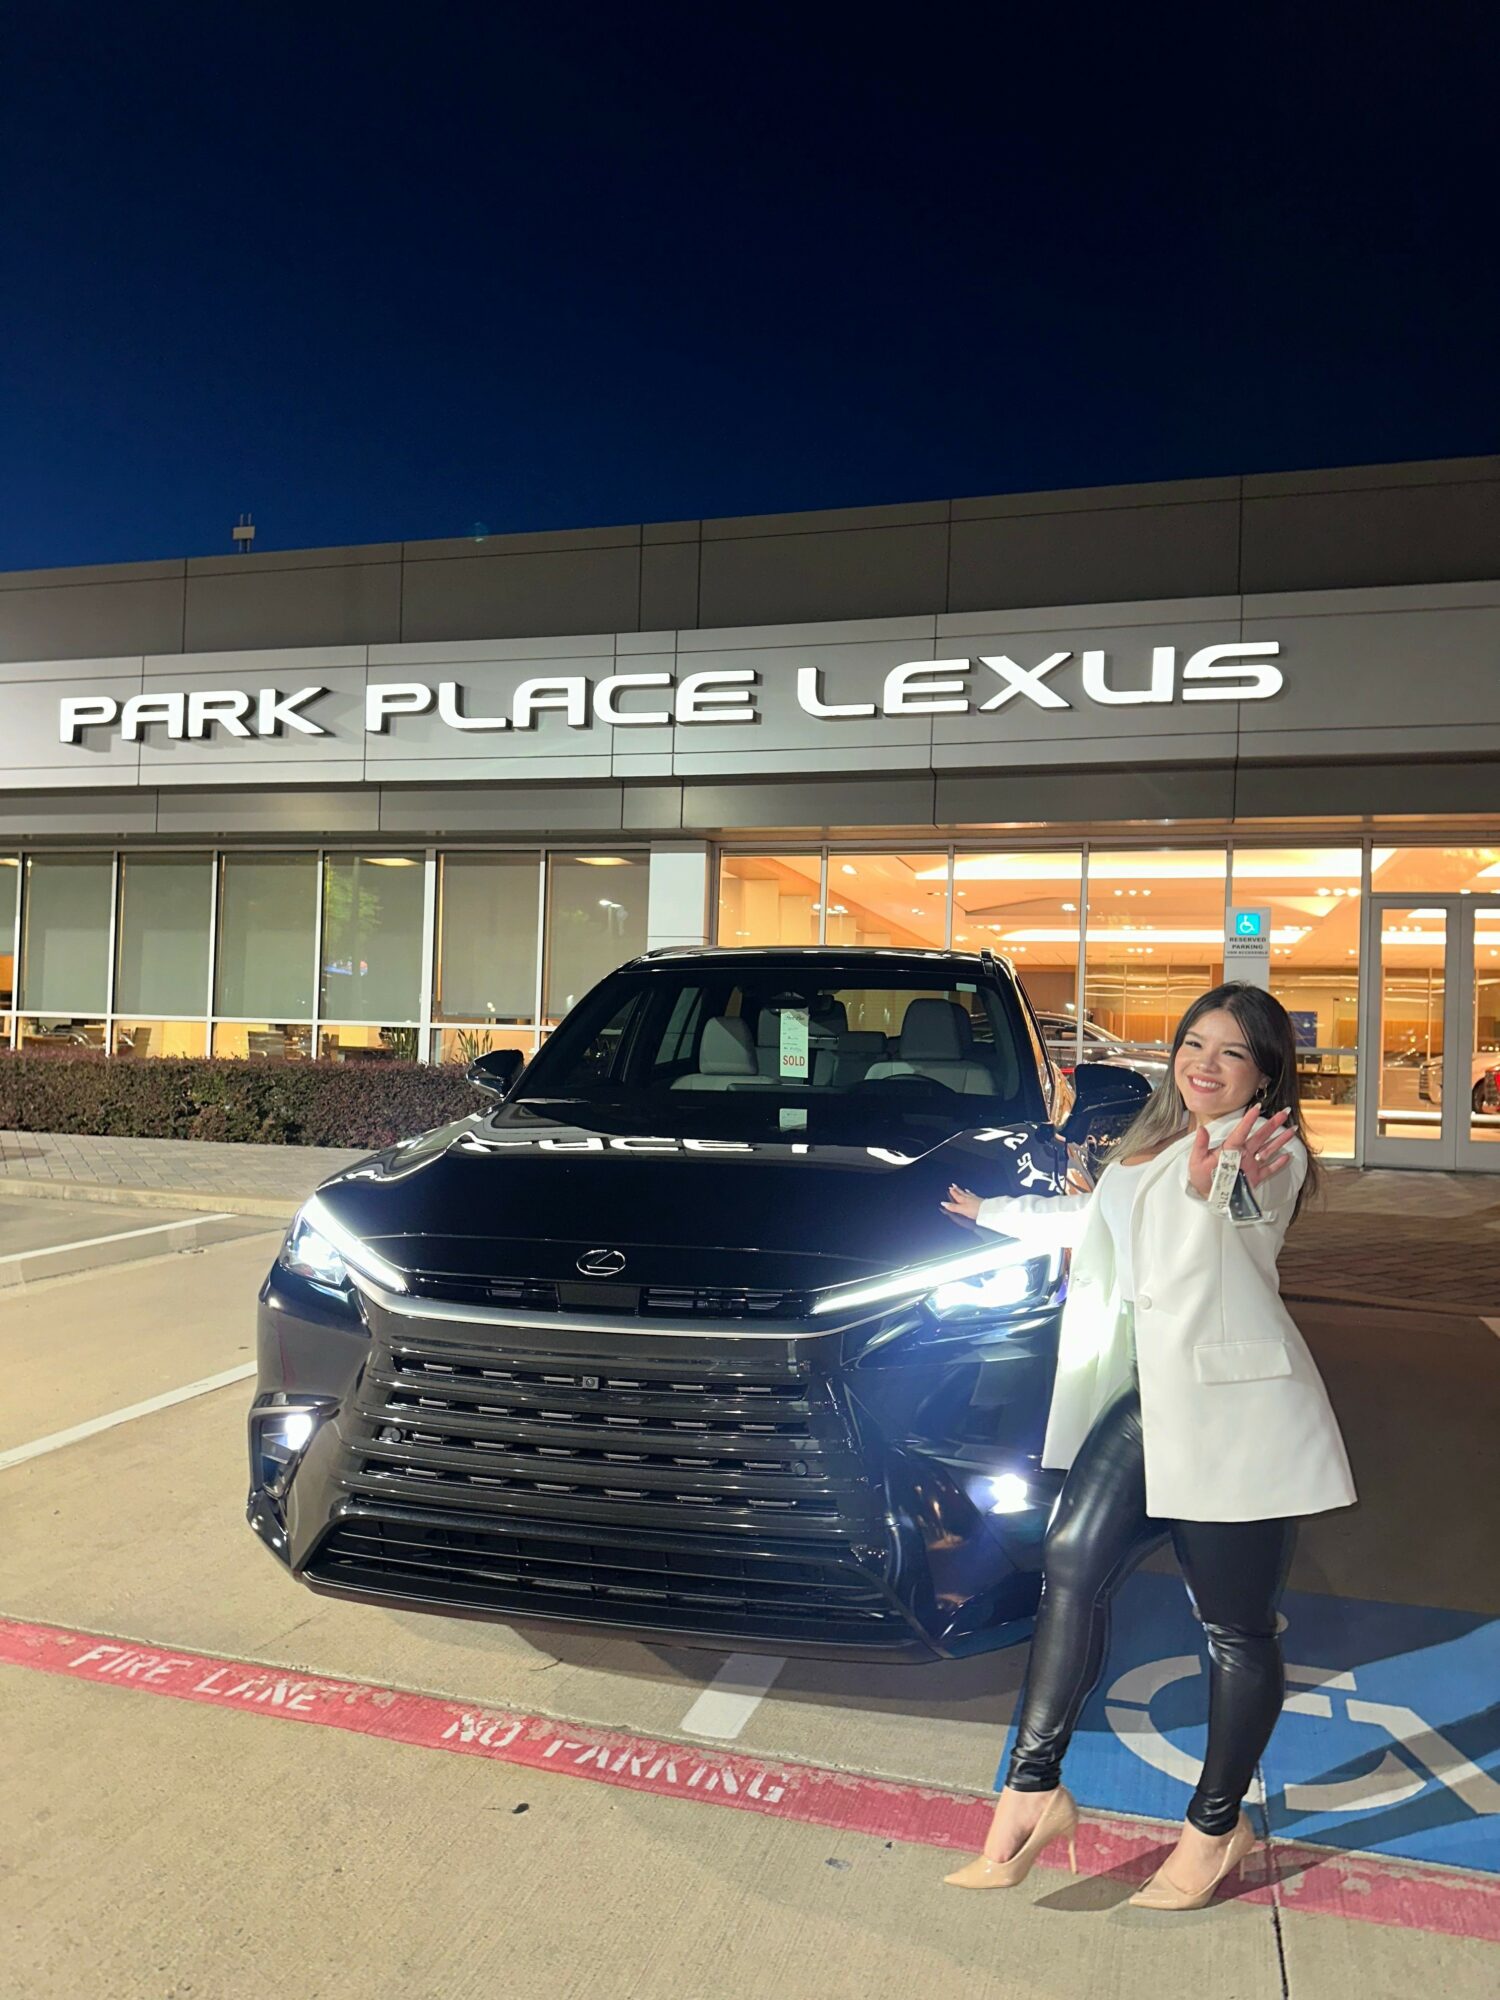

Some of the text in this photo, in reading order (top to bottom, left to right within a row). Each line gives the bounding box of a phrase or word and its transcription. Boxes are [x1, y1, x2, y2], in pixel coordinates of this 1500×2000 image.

[59, 641, 1283, 742] PARK PLACE LEXUS
[783, 1055, 805, 1066] SOLD
[67, 1645, 317, 1711] FIRE LANE
[441, 1713, 789, 1803] NO PARKING
